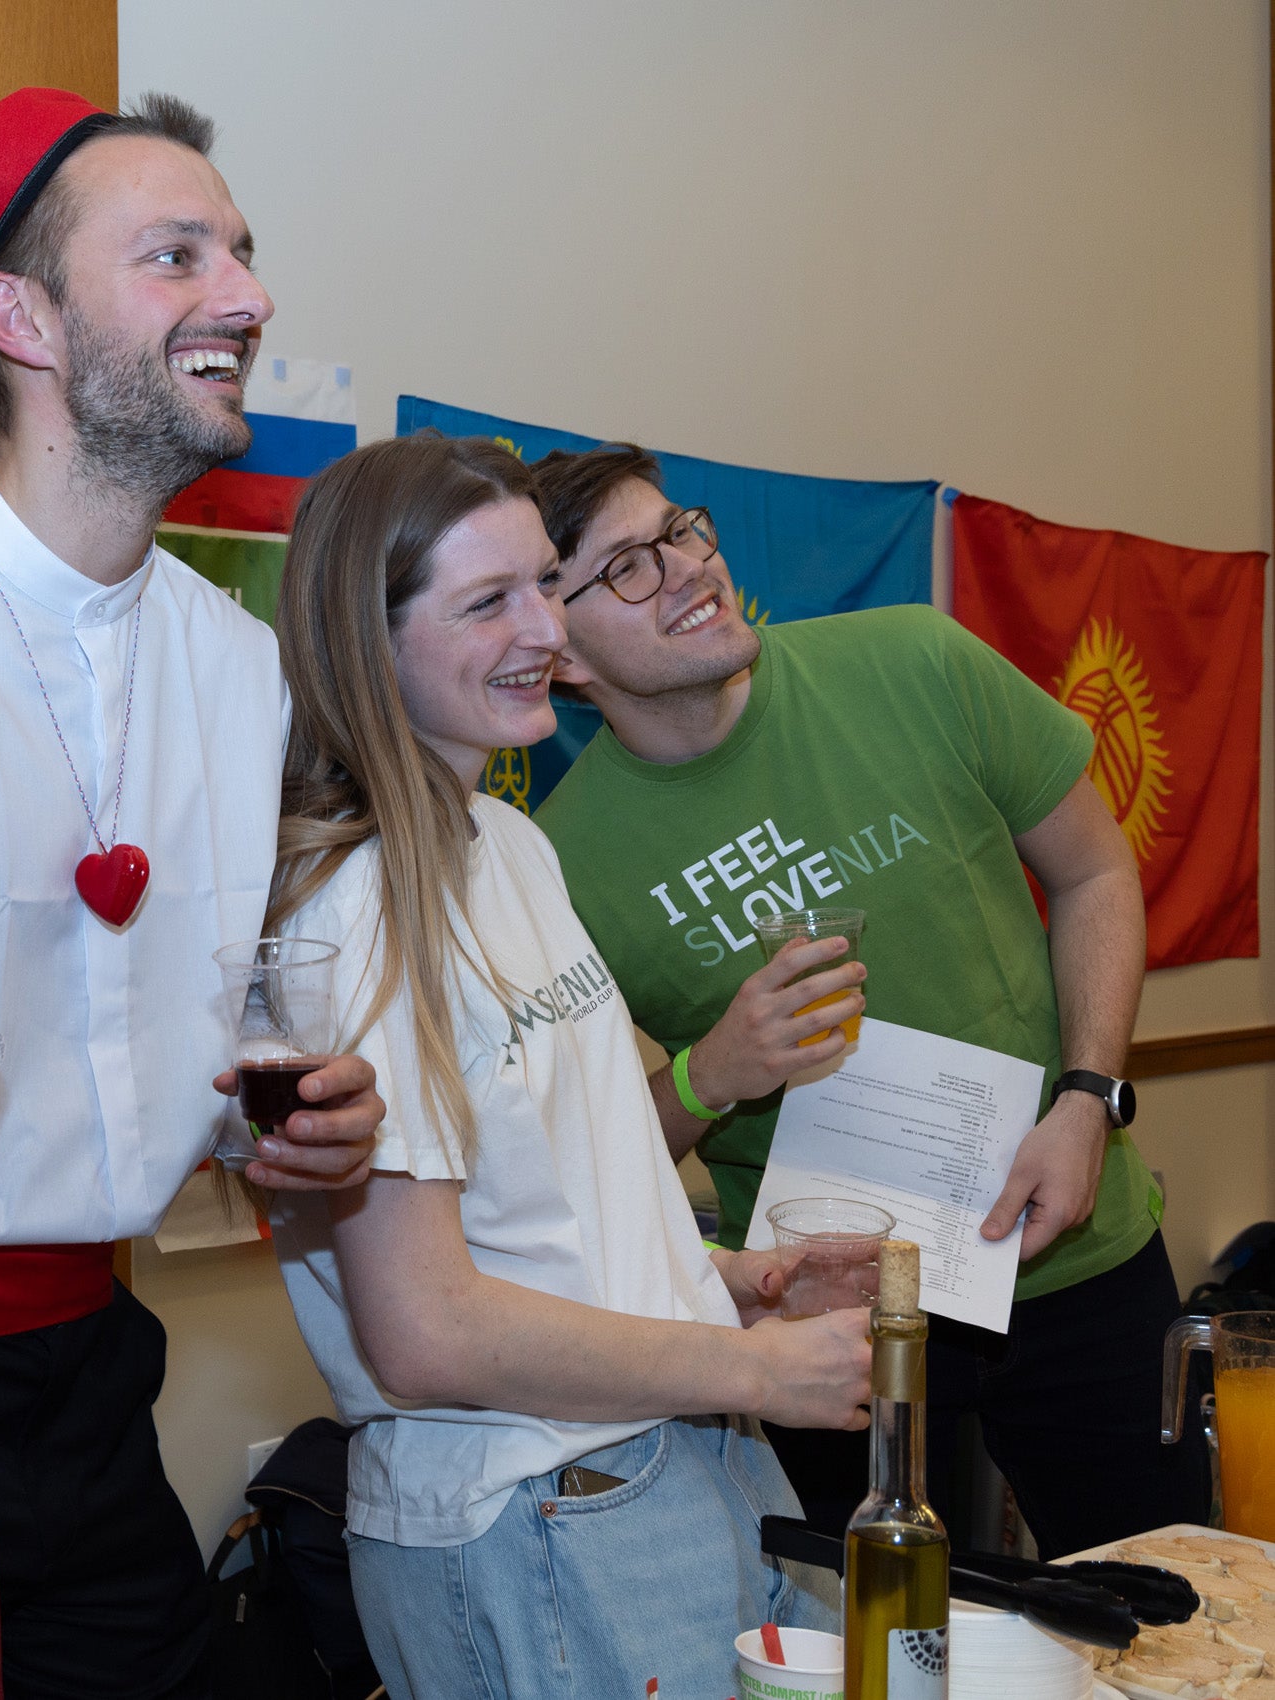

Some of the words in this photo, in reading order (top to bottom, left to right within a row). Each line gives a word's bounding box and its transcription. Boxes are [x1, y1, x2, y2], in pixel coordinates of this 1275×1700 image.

[650, 882, 687, 926] I
[681, 818, 806, 907] FEEL
[684, 813, 930, 967] SLOVENIA
[570, 1000, 598, 1023] WORLD
[597, 987, 613, 1004] CUP
